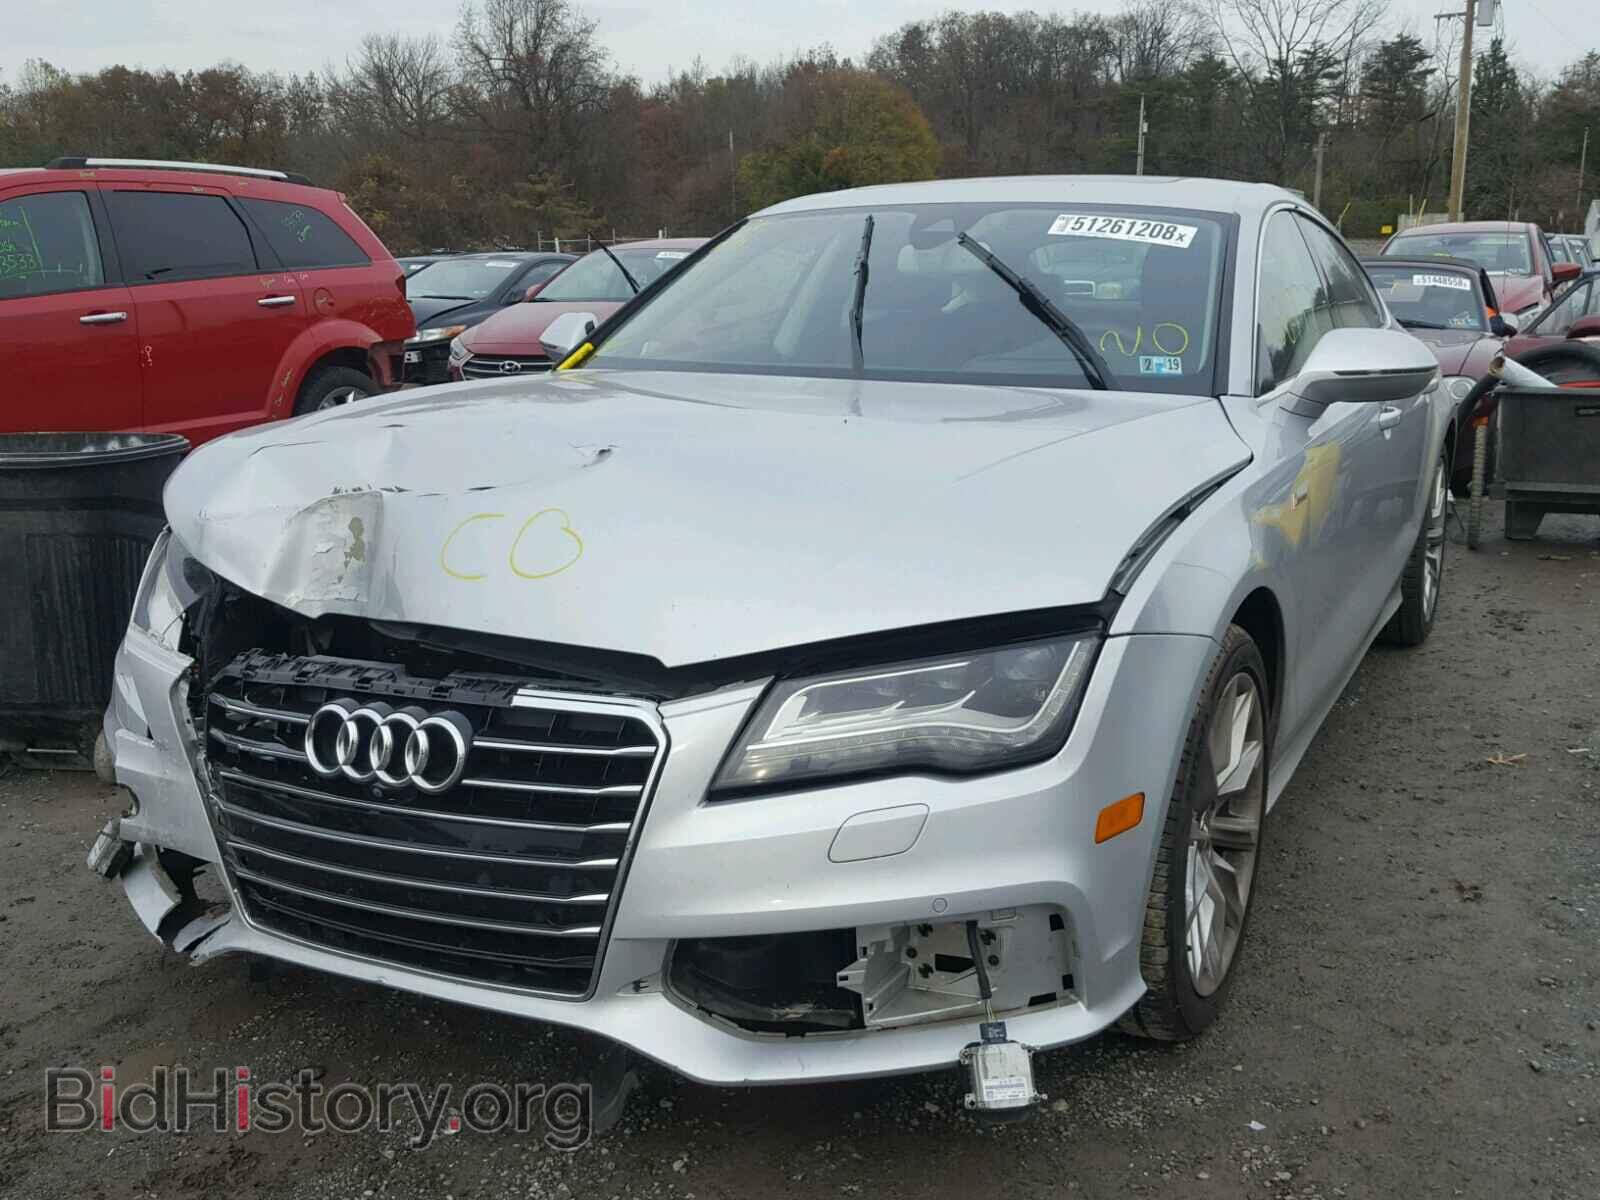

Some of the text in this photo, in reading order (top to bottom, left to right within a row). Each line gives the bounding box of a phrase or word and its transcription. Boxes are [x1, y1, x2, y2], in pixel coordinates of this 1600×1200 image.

[1100, 323, 1188, 356] NO
[1144, 358, 1180, 371] 2 19
